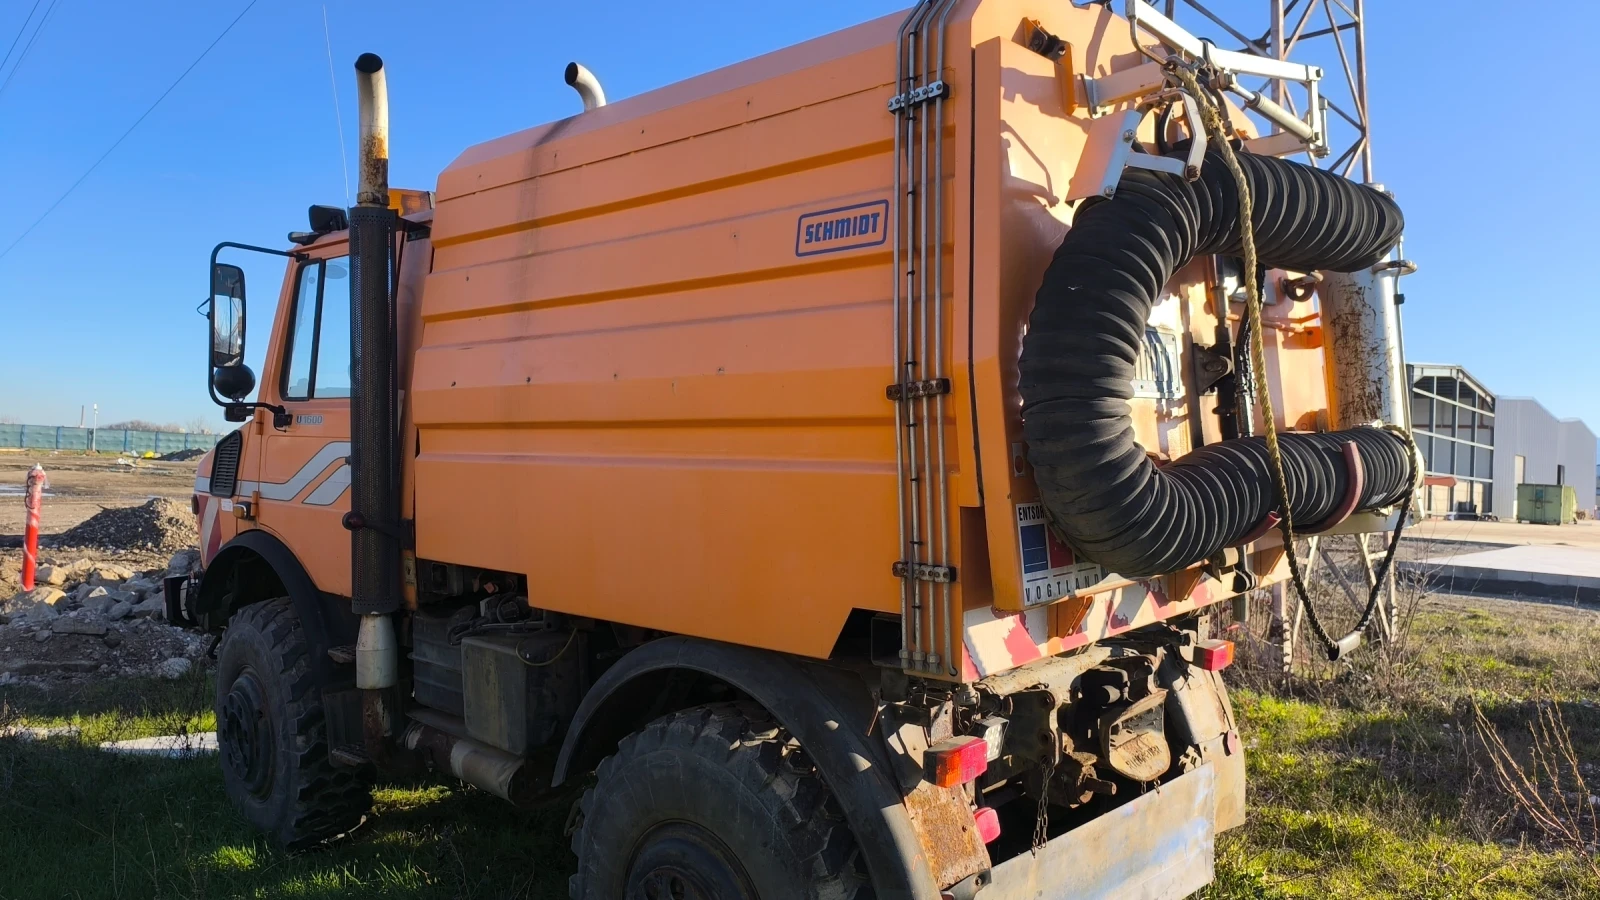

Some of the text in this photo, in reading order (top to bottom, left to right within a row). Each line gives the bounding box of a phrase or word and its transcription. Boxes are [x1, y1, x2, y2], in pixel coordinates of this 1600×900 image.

[805, 212, 880, 244] SCHMIDT
[296, 415, 302, 424] U
[1018, 505, 1047, 521] ENTSOR
[1025, 573, 1099, 602] VOGTLAND
